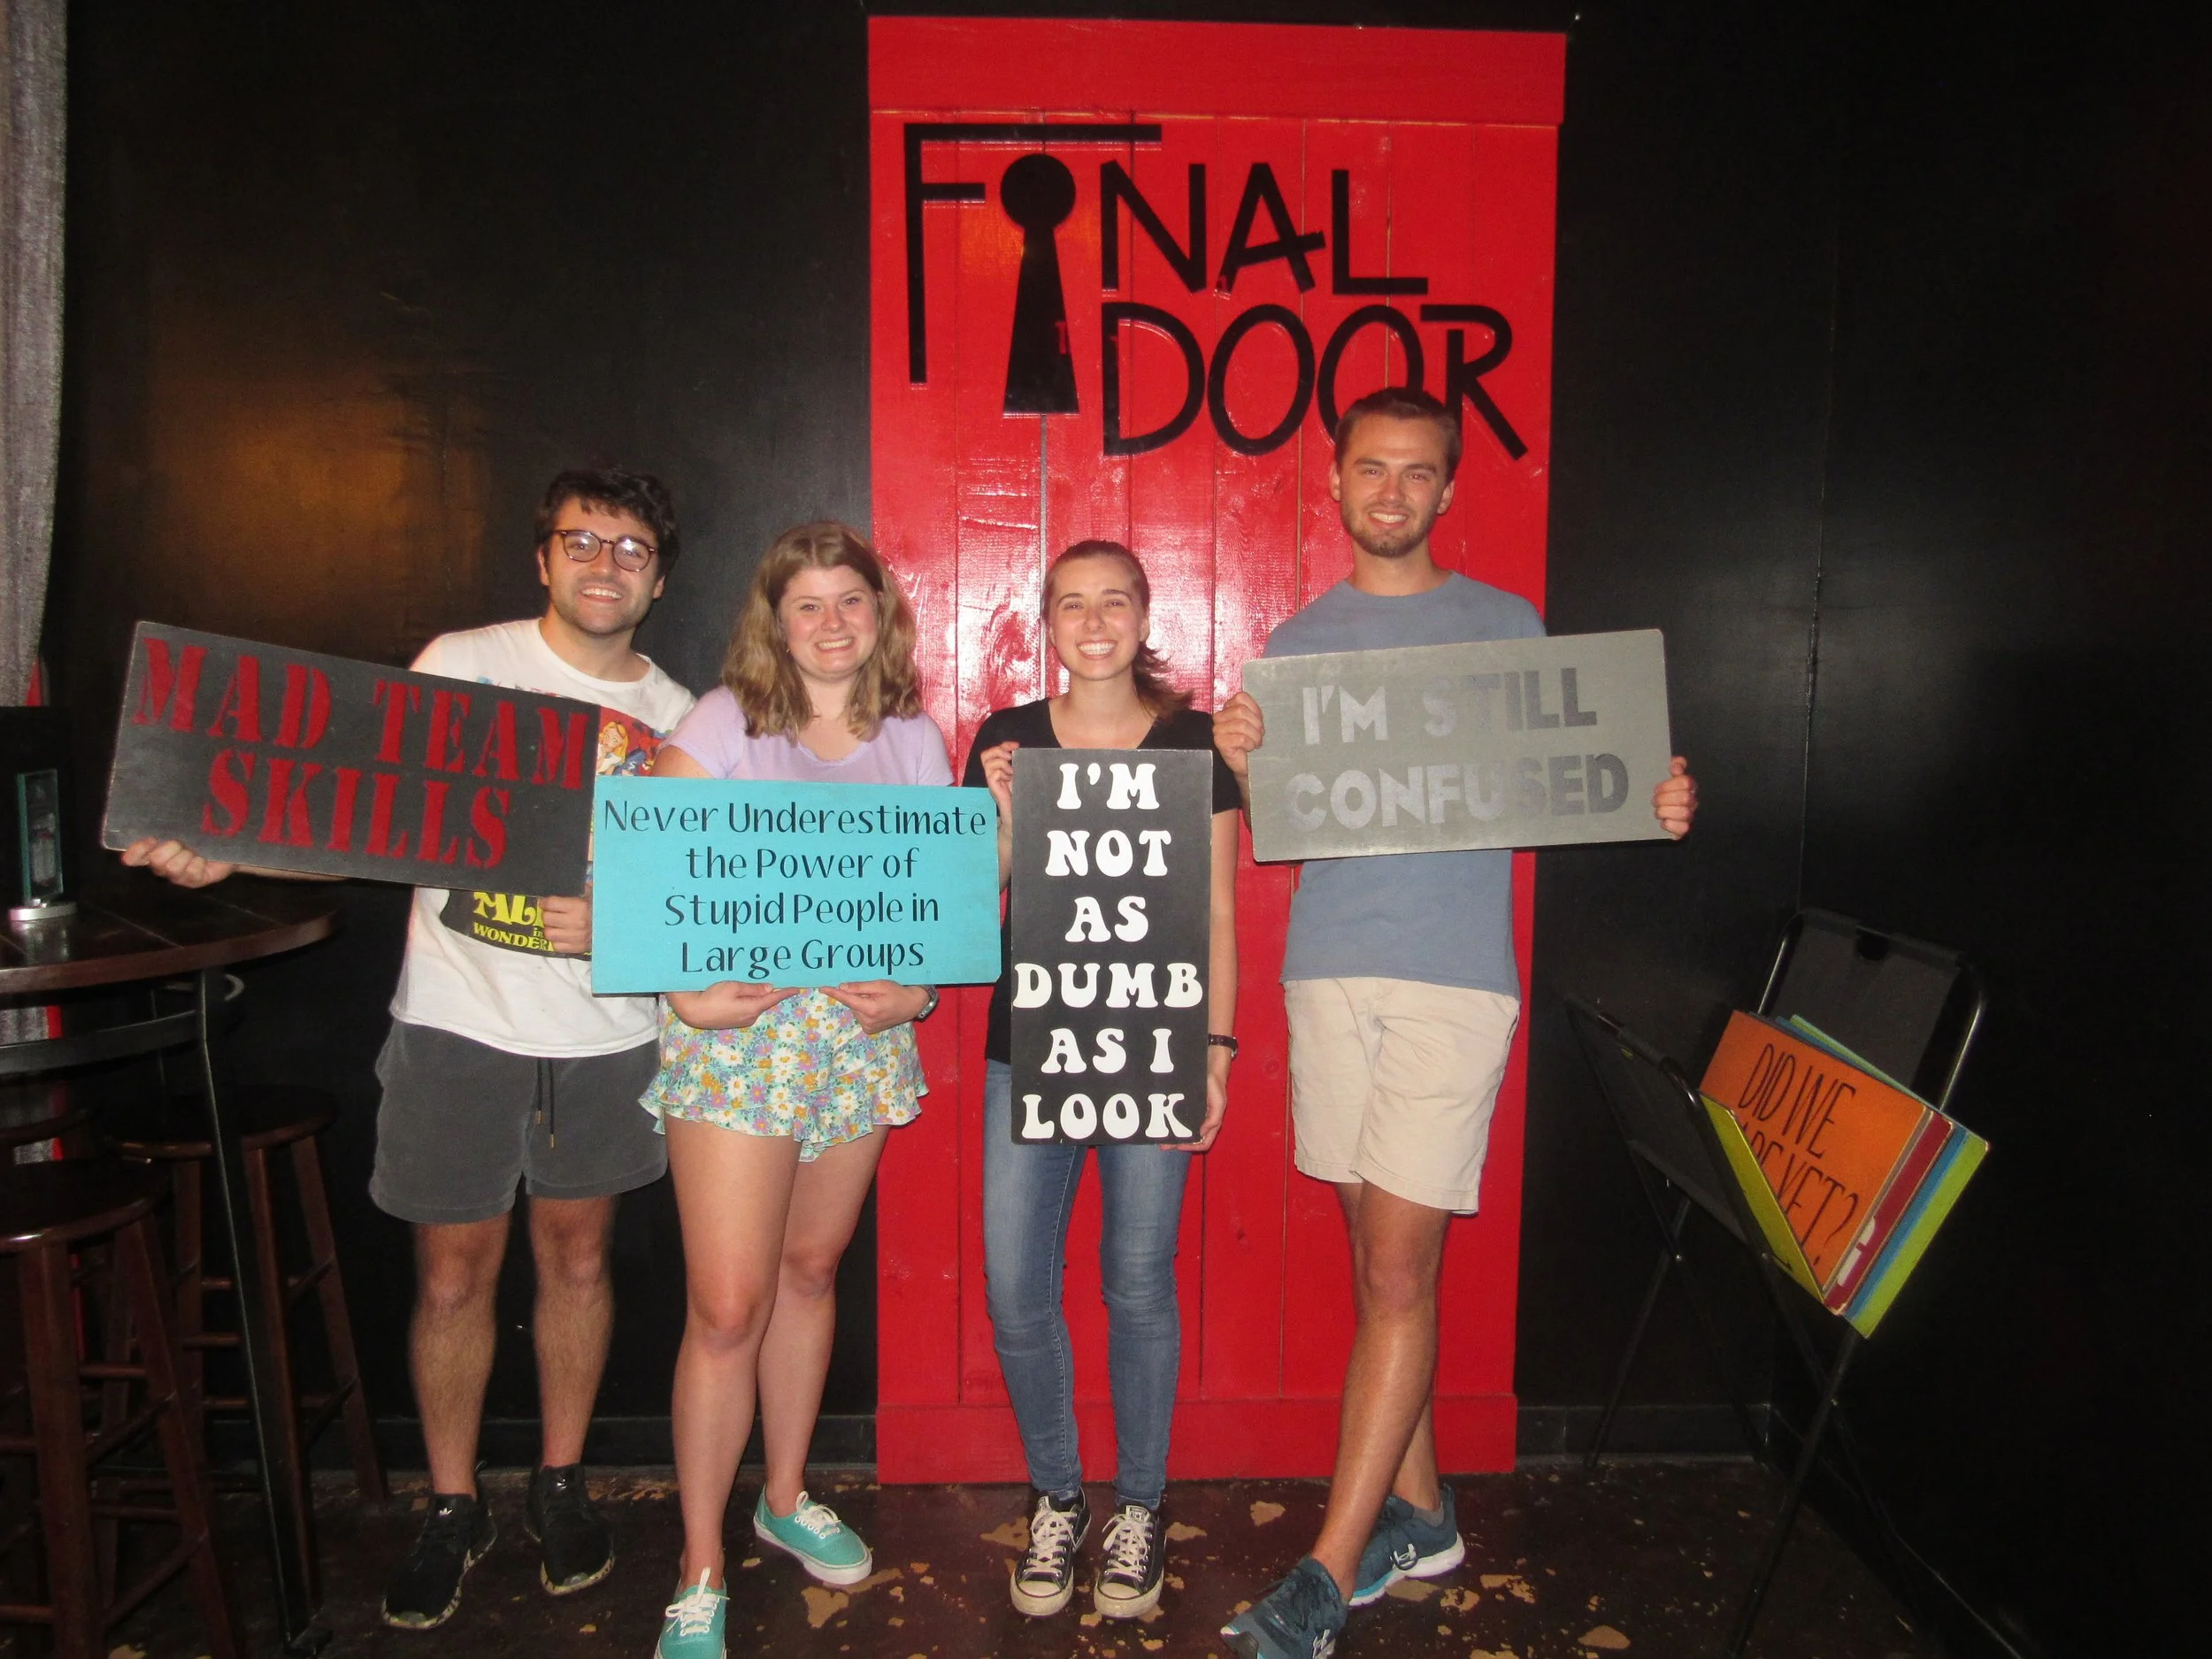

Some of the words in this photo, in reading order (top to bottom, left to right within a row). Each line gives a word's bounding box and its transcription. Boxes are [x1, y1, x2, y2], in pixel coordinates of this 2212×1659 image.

[1101, 301, 1528, 460] DOOR
[130, 636, 330, 750] MAD
[371, 678, 589, 790] TEAM
[1302, 684, 1389, 745] I'M
[1423, 667, 1598, 738] STILL
[200, 749, 510, 870] SKILLS
[1056, 763, 1160, 810] I'M
[1283, 753, 1630, 832] CONFUSED
[604, 800, 719, 832] Never
[728, 801, 987, 835] Underestimate
[686, 846, 747, 879] the
[757, 848, 873, 879] Power
[882, 847, 921, 879] of
[1045, 829, 1171, 877] NOT
[664, 892, 785, 933] Stupid
[794, 891, 903, 932] People
[911, 892, 939, 922] in
[1064, 895, 1149, 942] AS
[681, 941, 792, 979] Large
[802, 938, 925, 976] Groups
[1012, 963, 1203, 1009] DUMB
[1041, 1027, 1127, 1074] AS
[1149, 1028, 1174, 1073] I
[1021, 1093, 1193, 1140] LOOK
[1737, 1042, 1796, 1122] DID
[1782, 1064, 1856, 1159] WE
